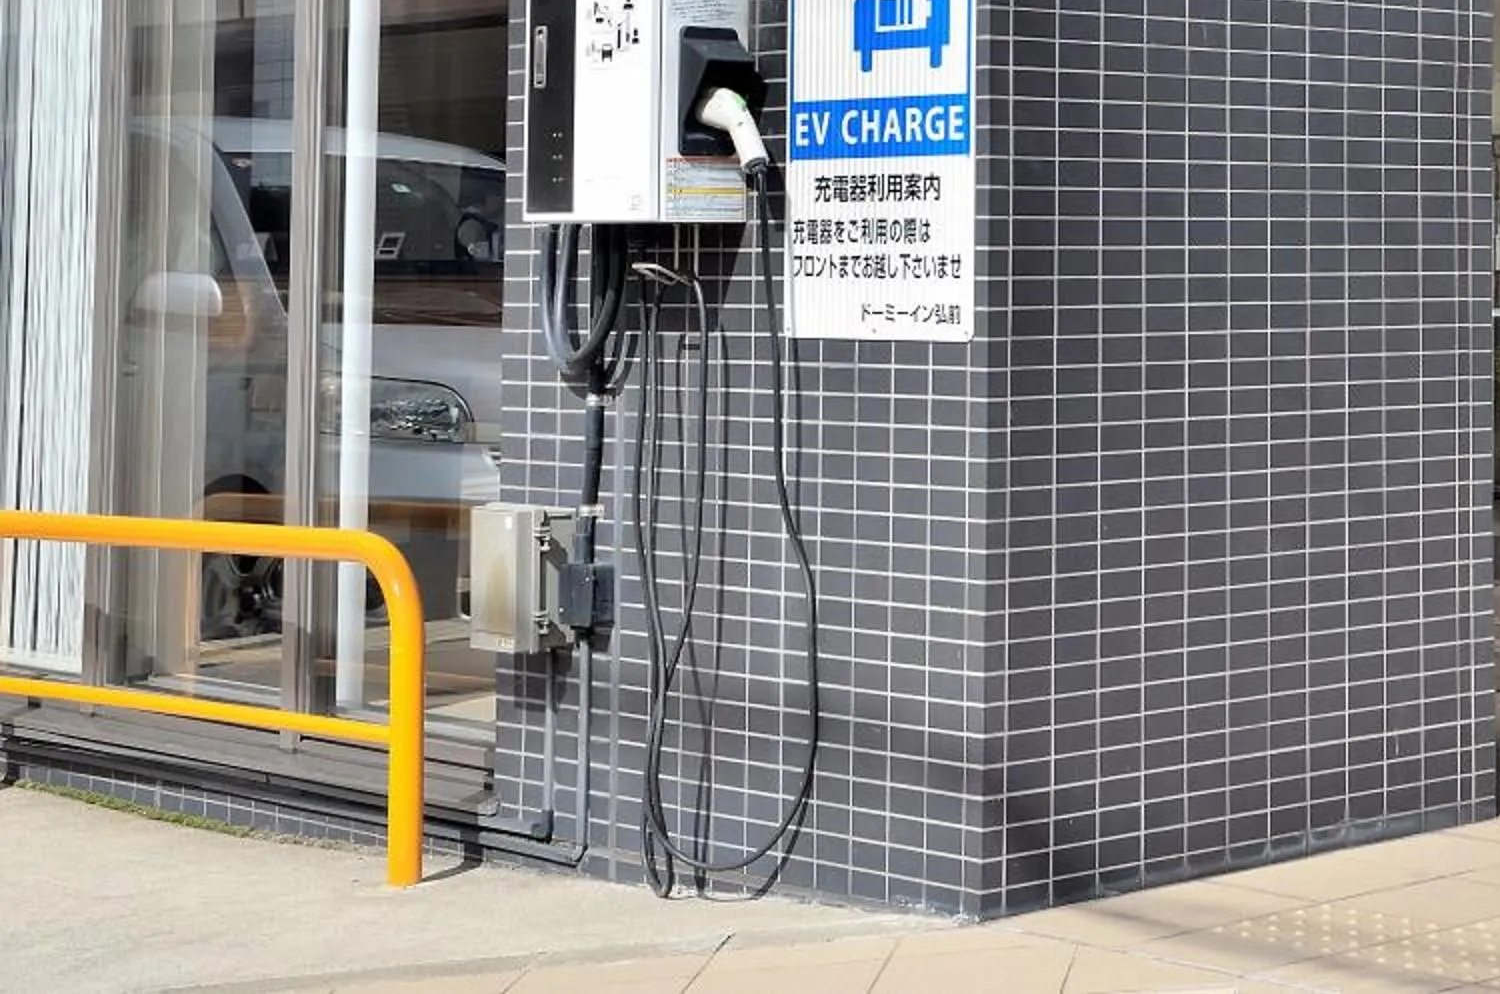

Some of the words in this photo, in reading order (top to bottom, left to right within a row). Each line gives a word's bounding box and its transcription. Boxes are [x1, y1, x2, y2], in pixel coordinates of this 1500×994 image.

[795, 111, 831, 147] EV
[841, 105, 965, 145] CHARGE
[814, 172, 941, 203] 充電器利用案内
[793, 218, 931, 245] 充電器をご利用の際は
[793, 254, 961, 280] フロントまでお越し下さいませ
[861, 303, 961, 325] ドーミーイン弘前
